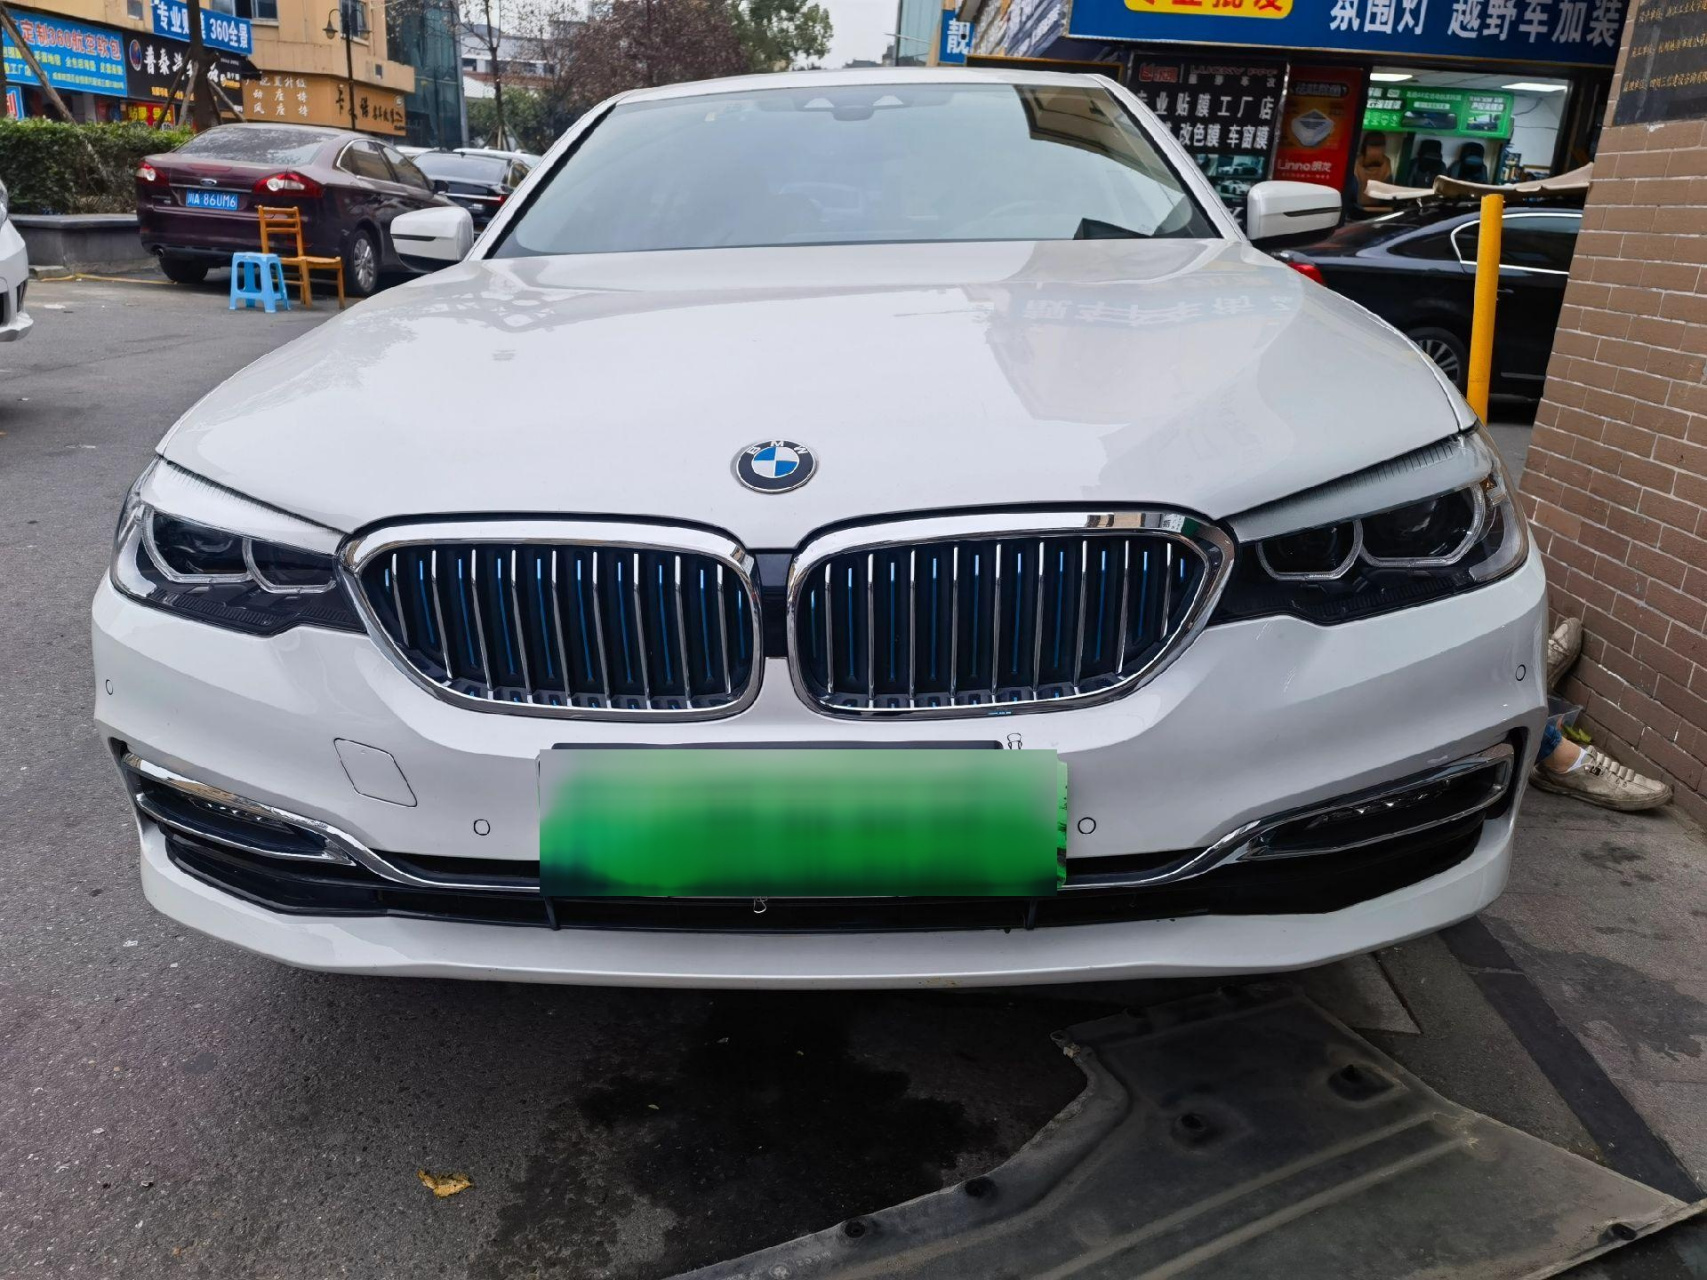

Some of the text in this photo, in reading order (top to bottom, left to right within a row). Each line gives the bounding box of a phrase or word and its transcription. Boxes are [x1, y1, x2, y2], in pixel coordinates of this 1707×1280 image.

[209, 18, 248, 48] 360全景
[1329, 0, 1427, 35] 氛围灯
[1447, 0, 1623, 48] 越野车加装
[1179, 122, 1221, 148] 改色膜
[1226, 123, 1271, 150] 车窗膜
[745, 441, 809, 455] BMW
